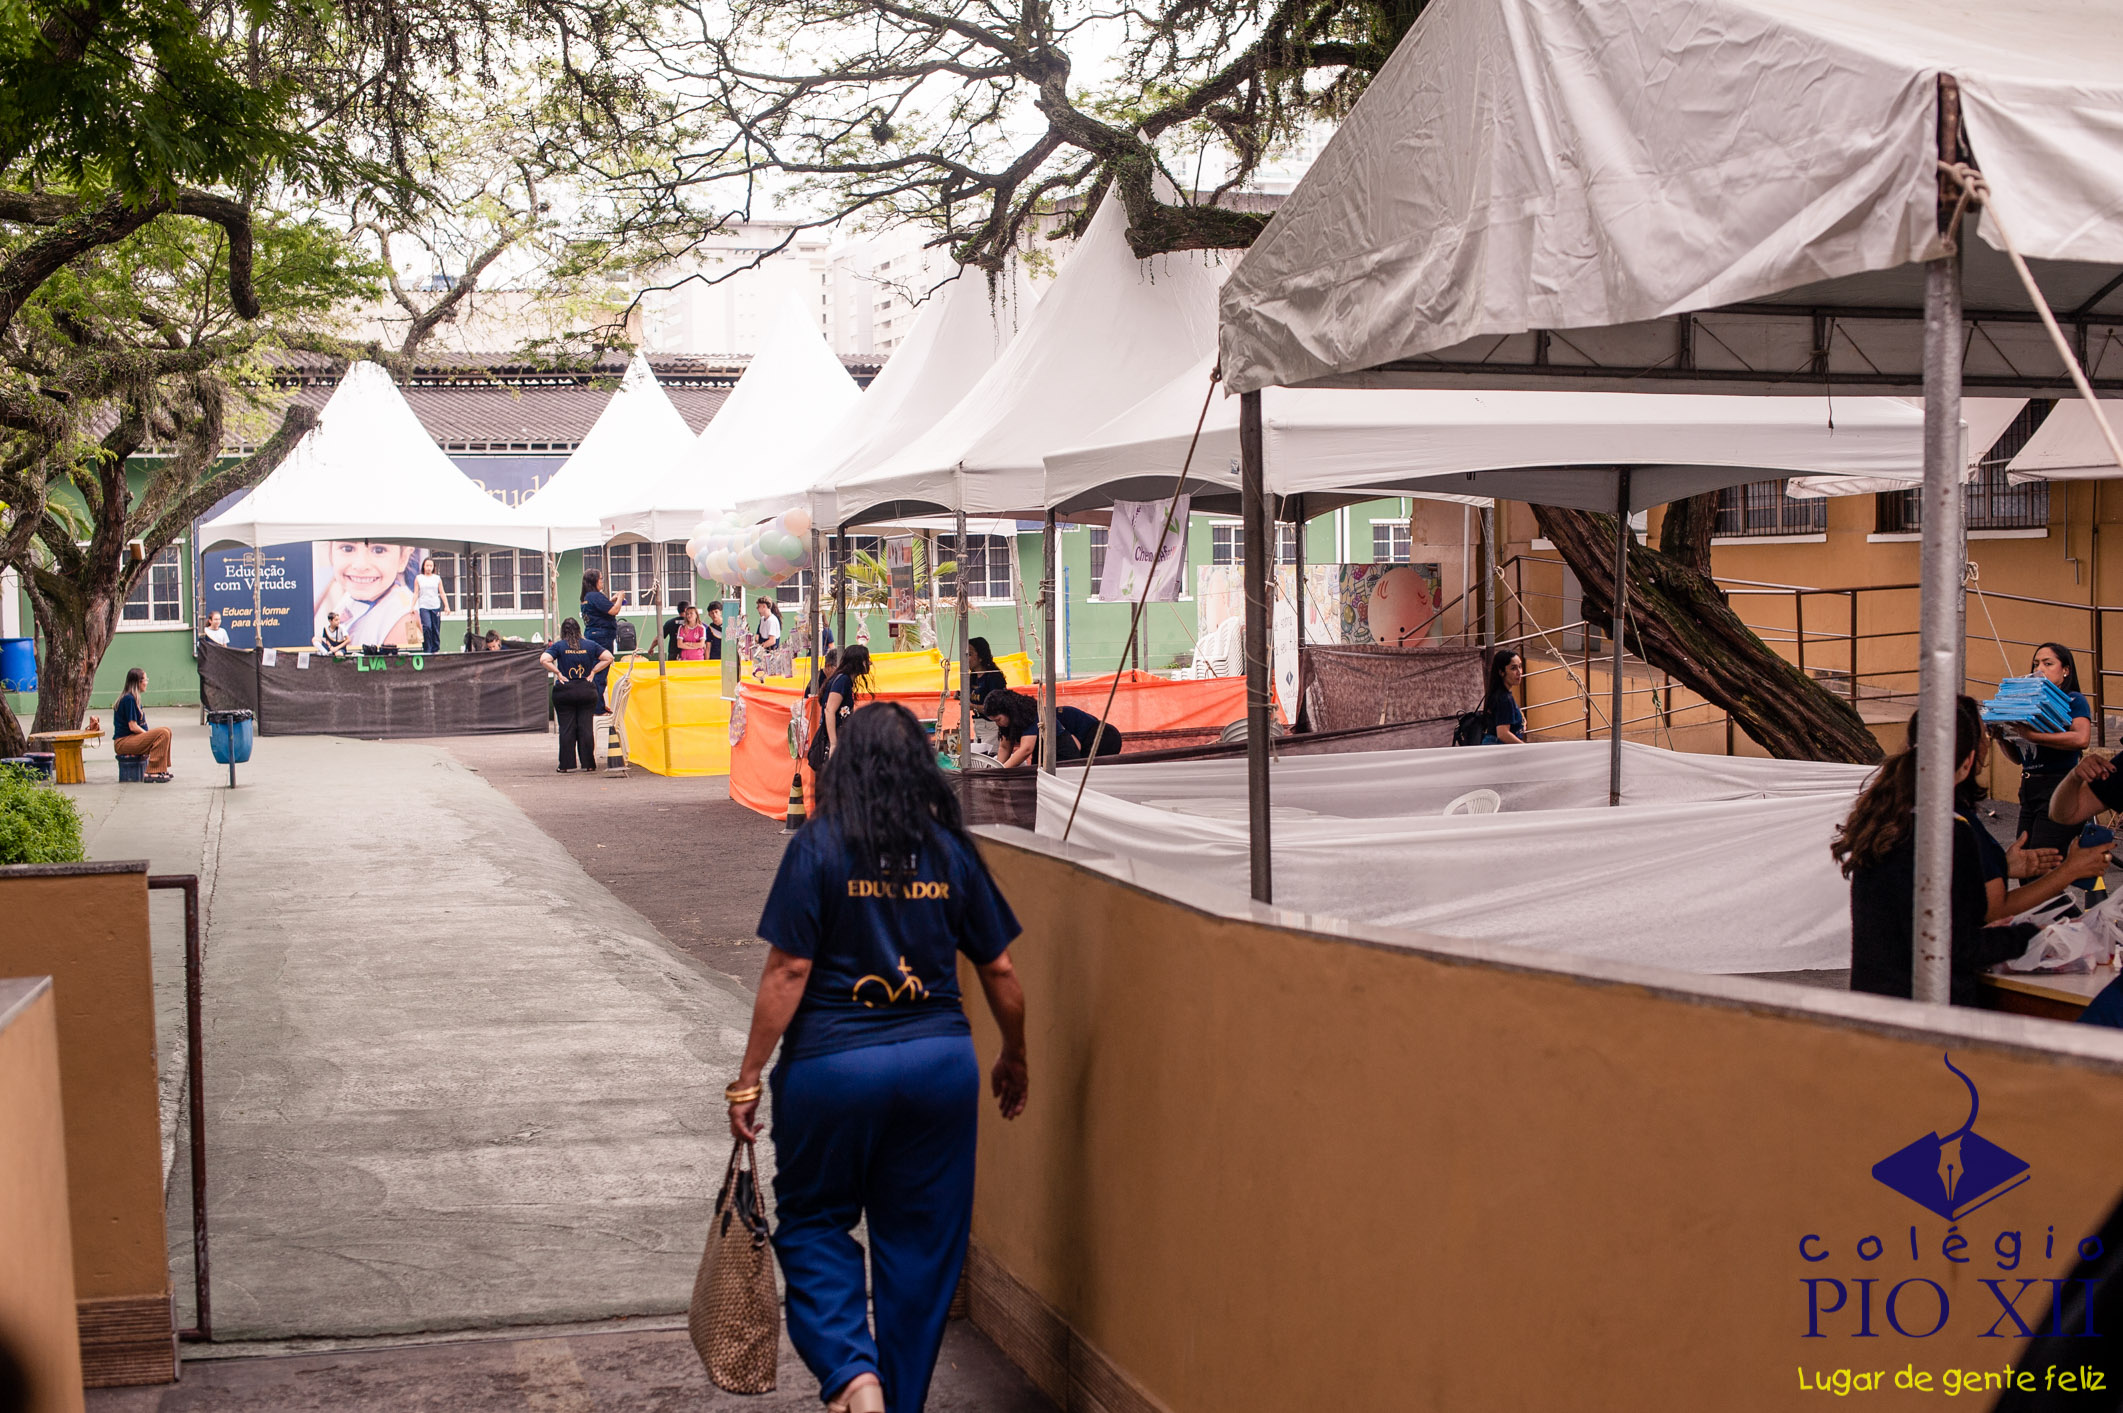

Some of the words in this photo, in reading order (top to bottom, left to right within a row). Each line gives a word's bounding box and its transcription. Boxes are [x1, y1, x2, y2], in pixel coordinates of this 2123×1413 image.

[214, 581, 241, 591] com
[244, 577, 297, 590] Vrtudes
[222, 607, 253, 616] Educar
[262, 606, 290, 615] formar
[231, 620, 251, 629] para
[260, 617, 280, 626] vida.
